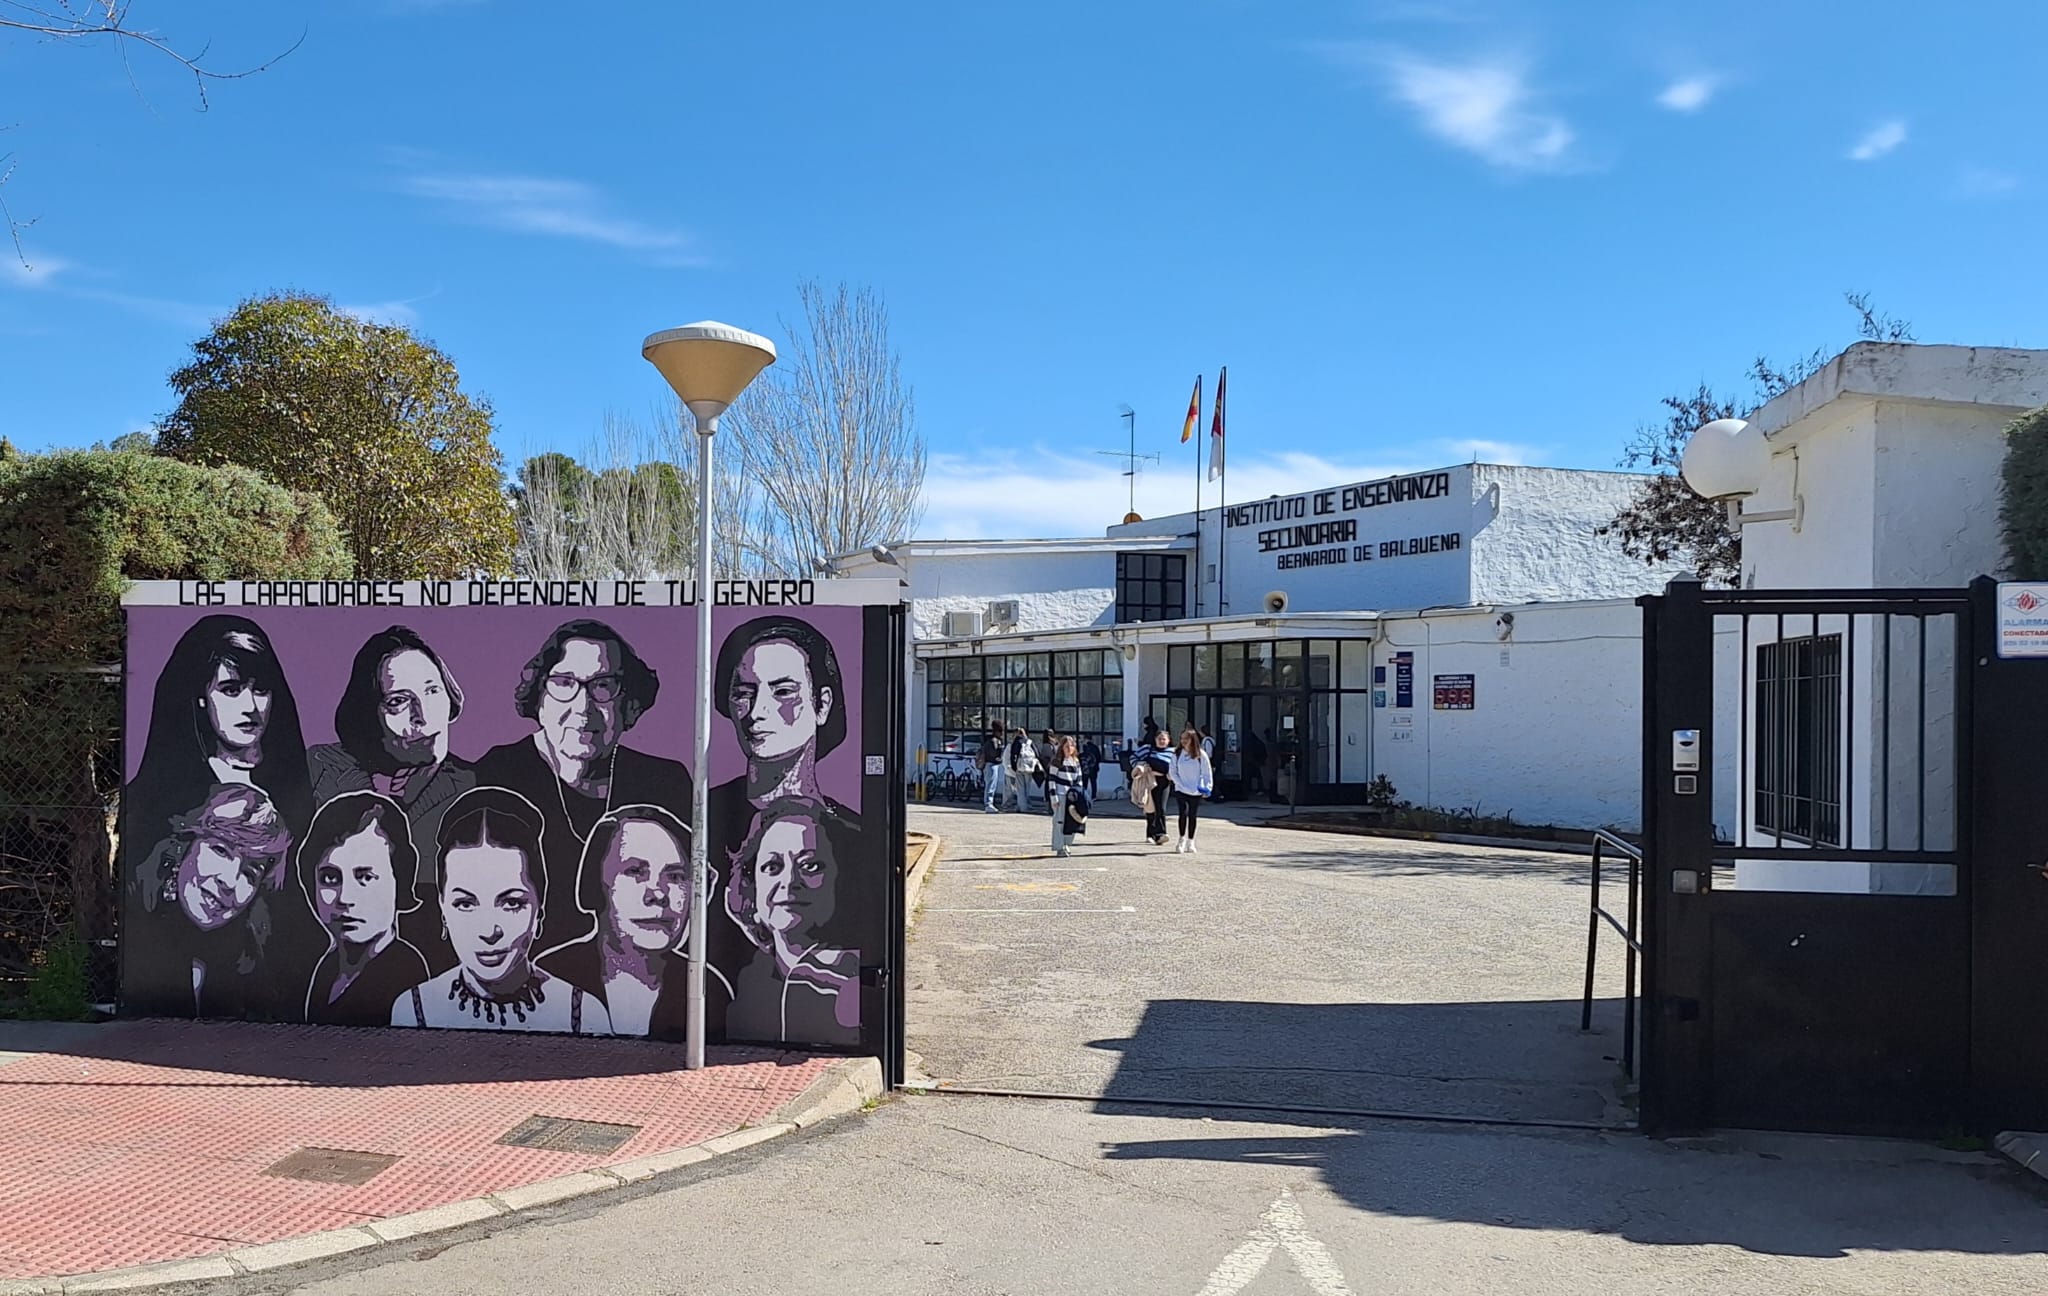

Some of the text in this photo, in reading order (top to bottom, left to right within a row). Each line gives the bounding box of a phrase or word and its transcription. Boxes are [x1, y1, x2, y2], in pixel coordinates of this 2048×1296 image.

[1226, 497, 1306, 529] INSTITUTO
[1313, 491, 1336, 516] DE
[1257, 519, 1358, 553] SECUNDARIA
[1277, 532, 1461, 570] BERNARDO DE BALBUENA
[179, 579, 815, 607] LAS CAPACIDADES NO DEPENDEN DE TU GENERO
